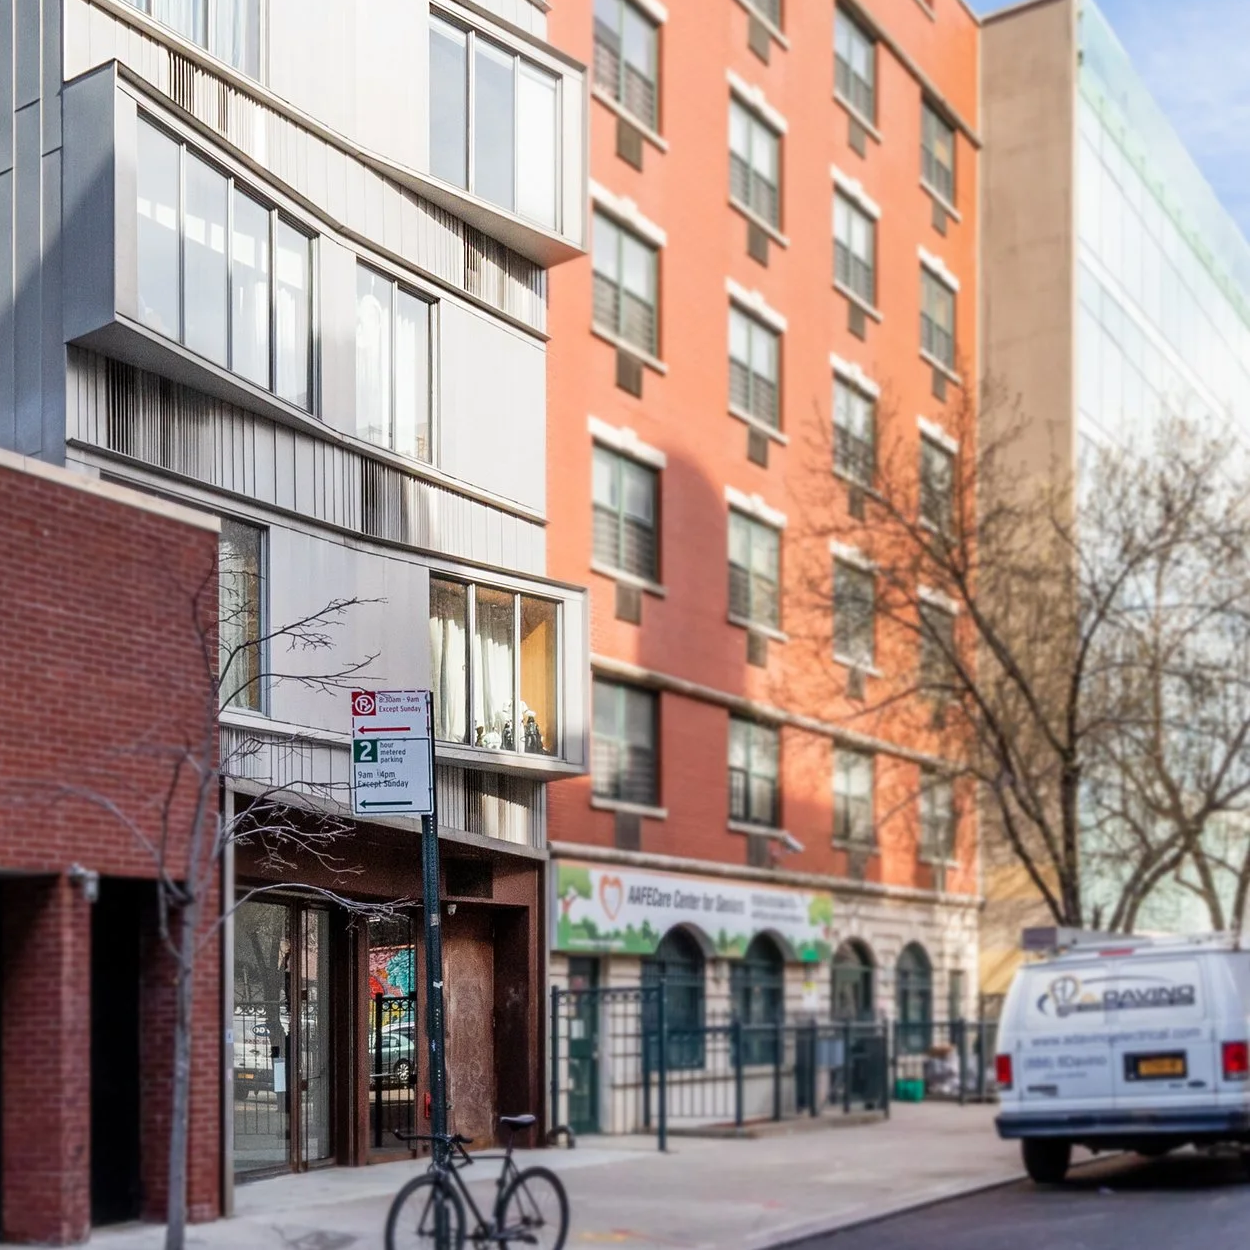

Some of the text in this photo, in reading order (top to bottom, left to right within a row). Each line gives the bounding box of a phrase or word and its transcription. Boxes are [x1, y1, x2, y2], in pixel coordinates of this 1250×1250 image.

[378, 705, 421, 713] Except Sunday
[359, 740, 373, 761] 2
[380, 756, 403, 764] parking
[357, 770, 374, 779] 9am
[357, 780, 409, 789] Except Sunday
[673, 888, 701, 912] Center
